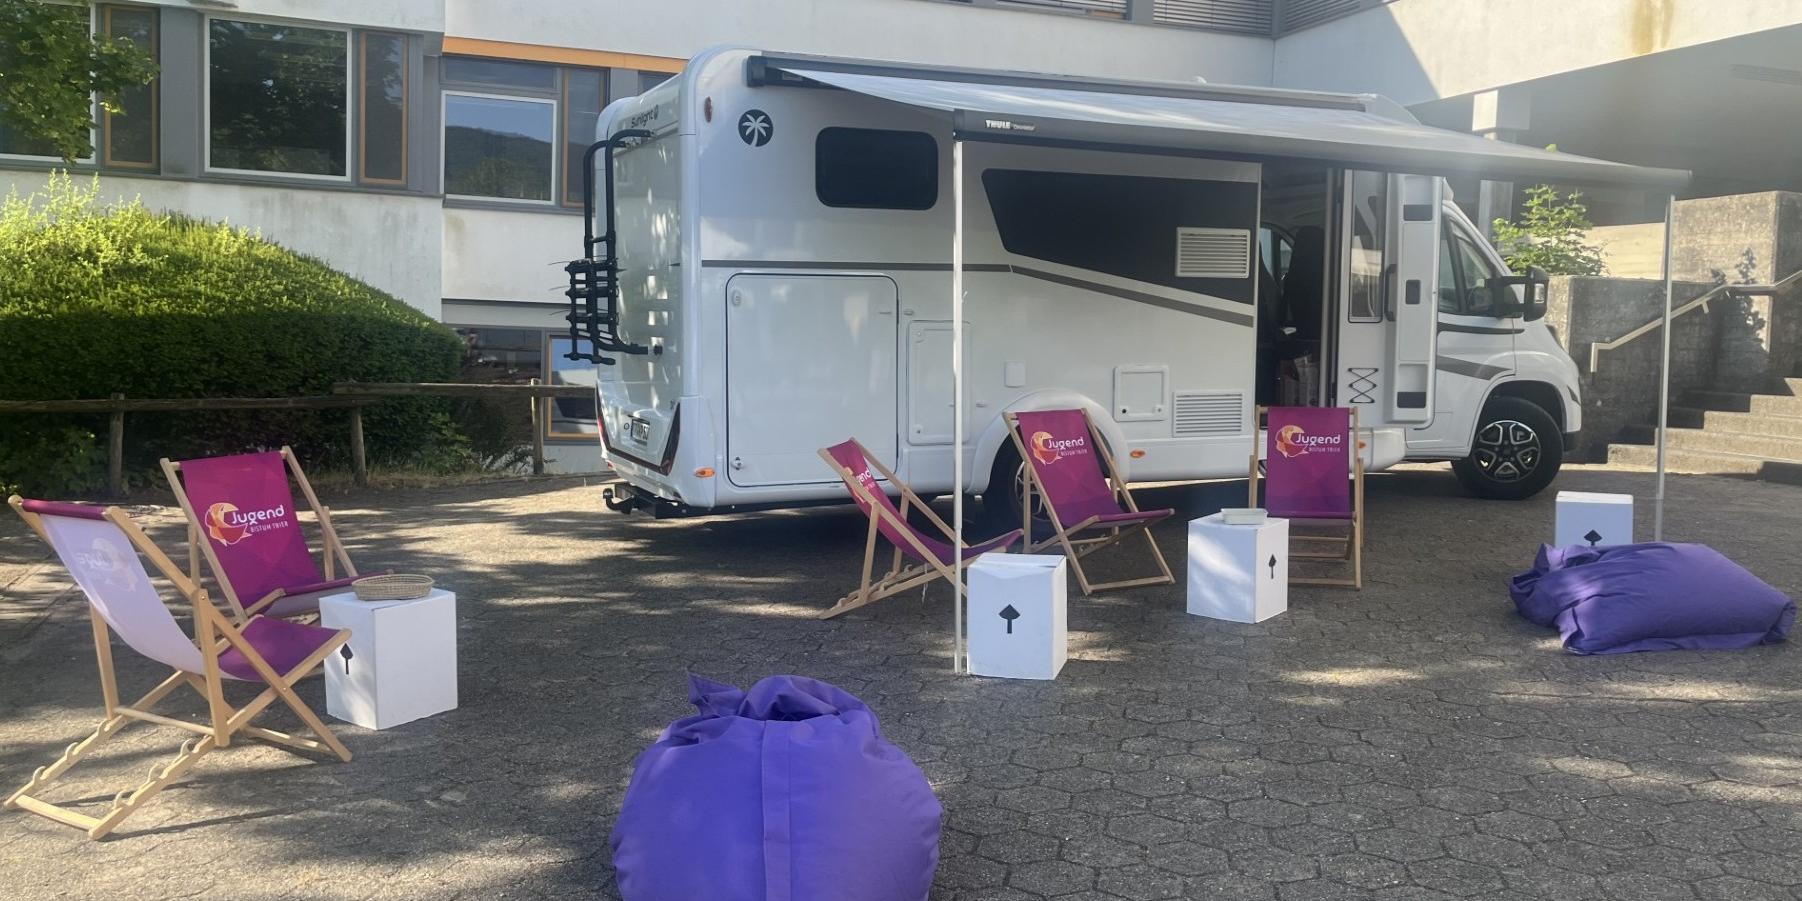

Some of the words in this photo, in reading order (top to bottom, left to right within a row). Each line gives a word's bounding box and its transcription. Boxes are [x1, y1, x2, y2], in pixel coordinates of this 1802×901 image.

[985, 119, 1011, 130] THULE
[1047, 436, 1085, 450] Jugend
[1295, 433, 1341, 446] Jugend
[231, 504, 285, 526] Jugend
[249, 523, 272, 533] BISTUM
[271, 520, 289, 529] TRIER
